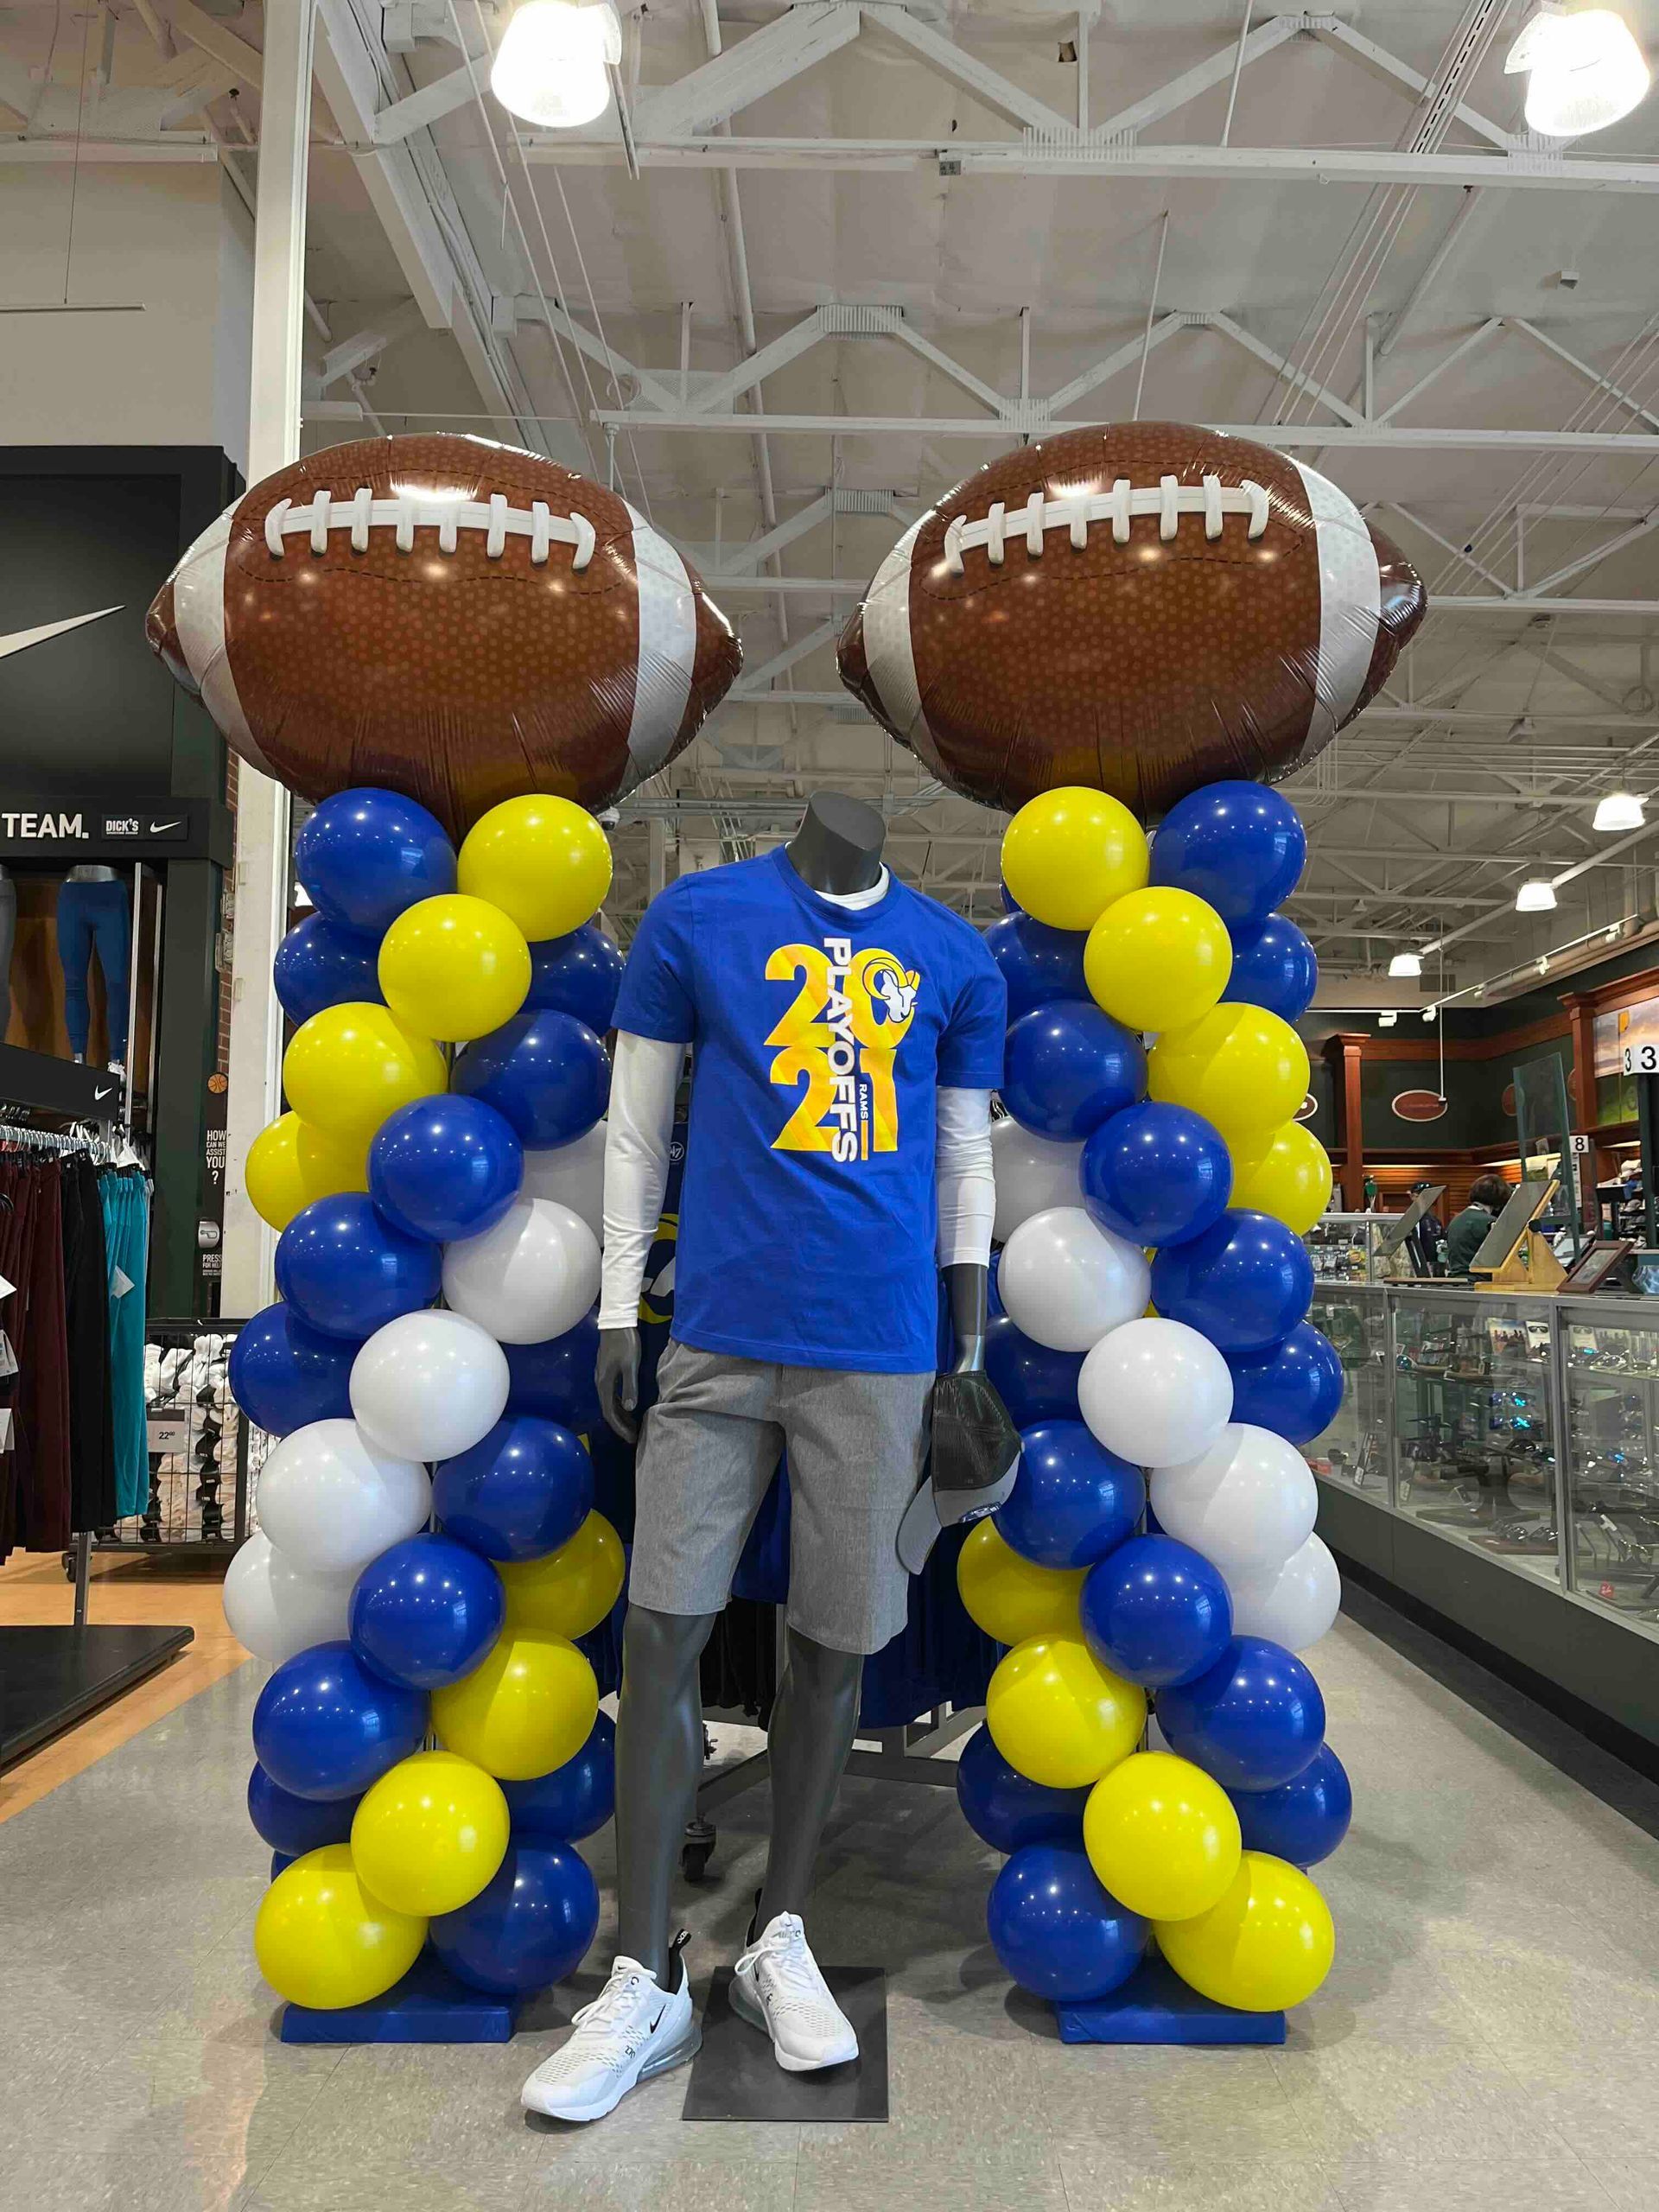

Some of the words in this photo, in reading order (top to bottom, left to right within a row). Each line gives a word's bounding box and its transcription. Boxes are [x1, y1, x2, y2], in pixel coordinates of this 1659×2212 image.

[2, 813, 90, 839] TEAM.
[105, 817, 139, 832] DICK'S
[823, 937, 858, 1163] PLAYOFFS
[1624, 1047, 1632, 1072] 3
[1640, 1046, 1657, 1071] 3
[858, 1083, 869, 1121] RAMS
[207, 1129, 226, 1141] HOW
[1575, 1137, 1585, 1151] 8
[206, 1156, 225, 1168] YOU
